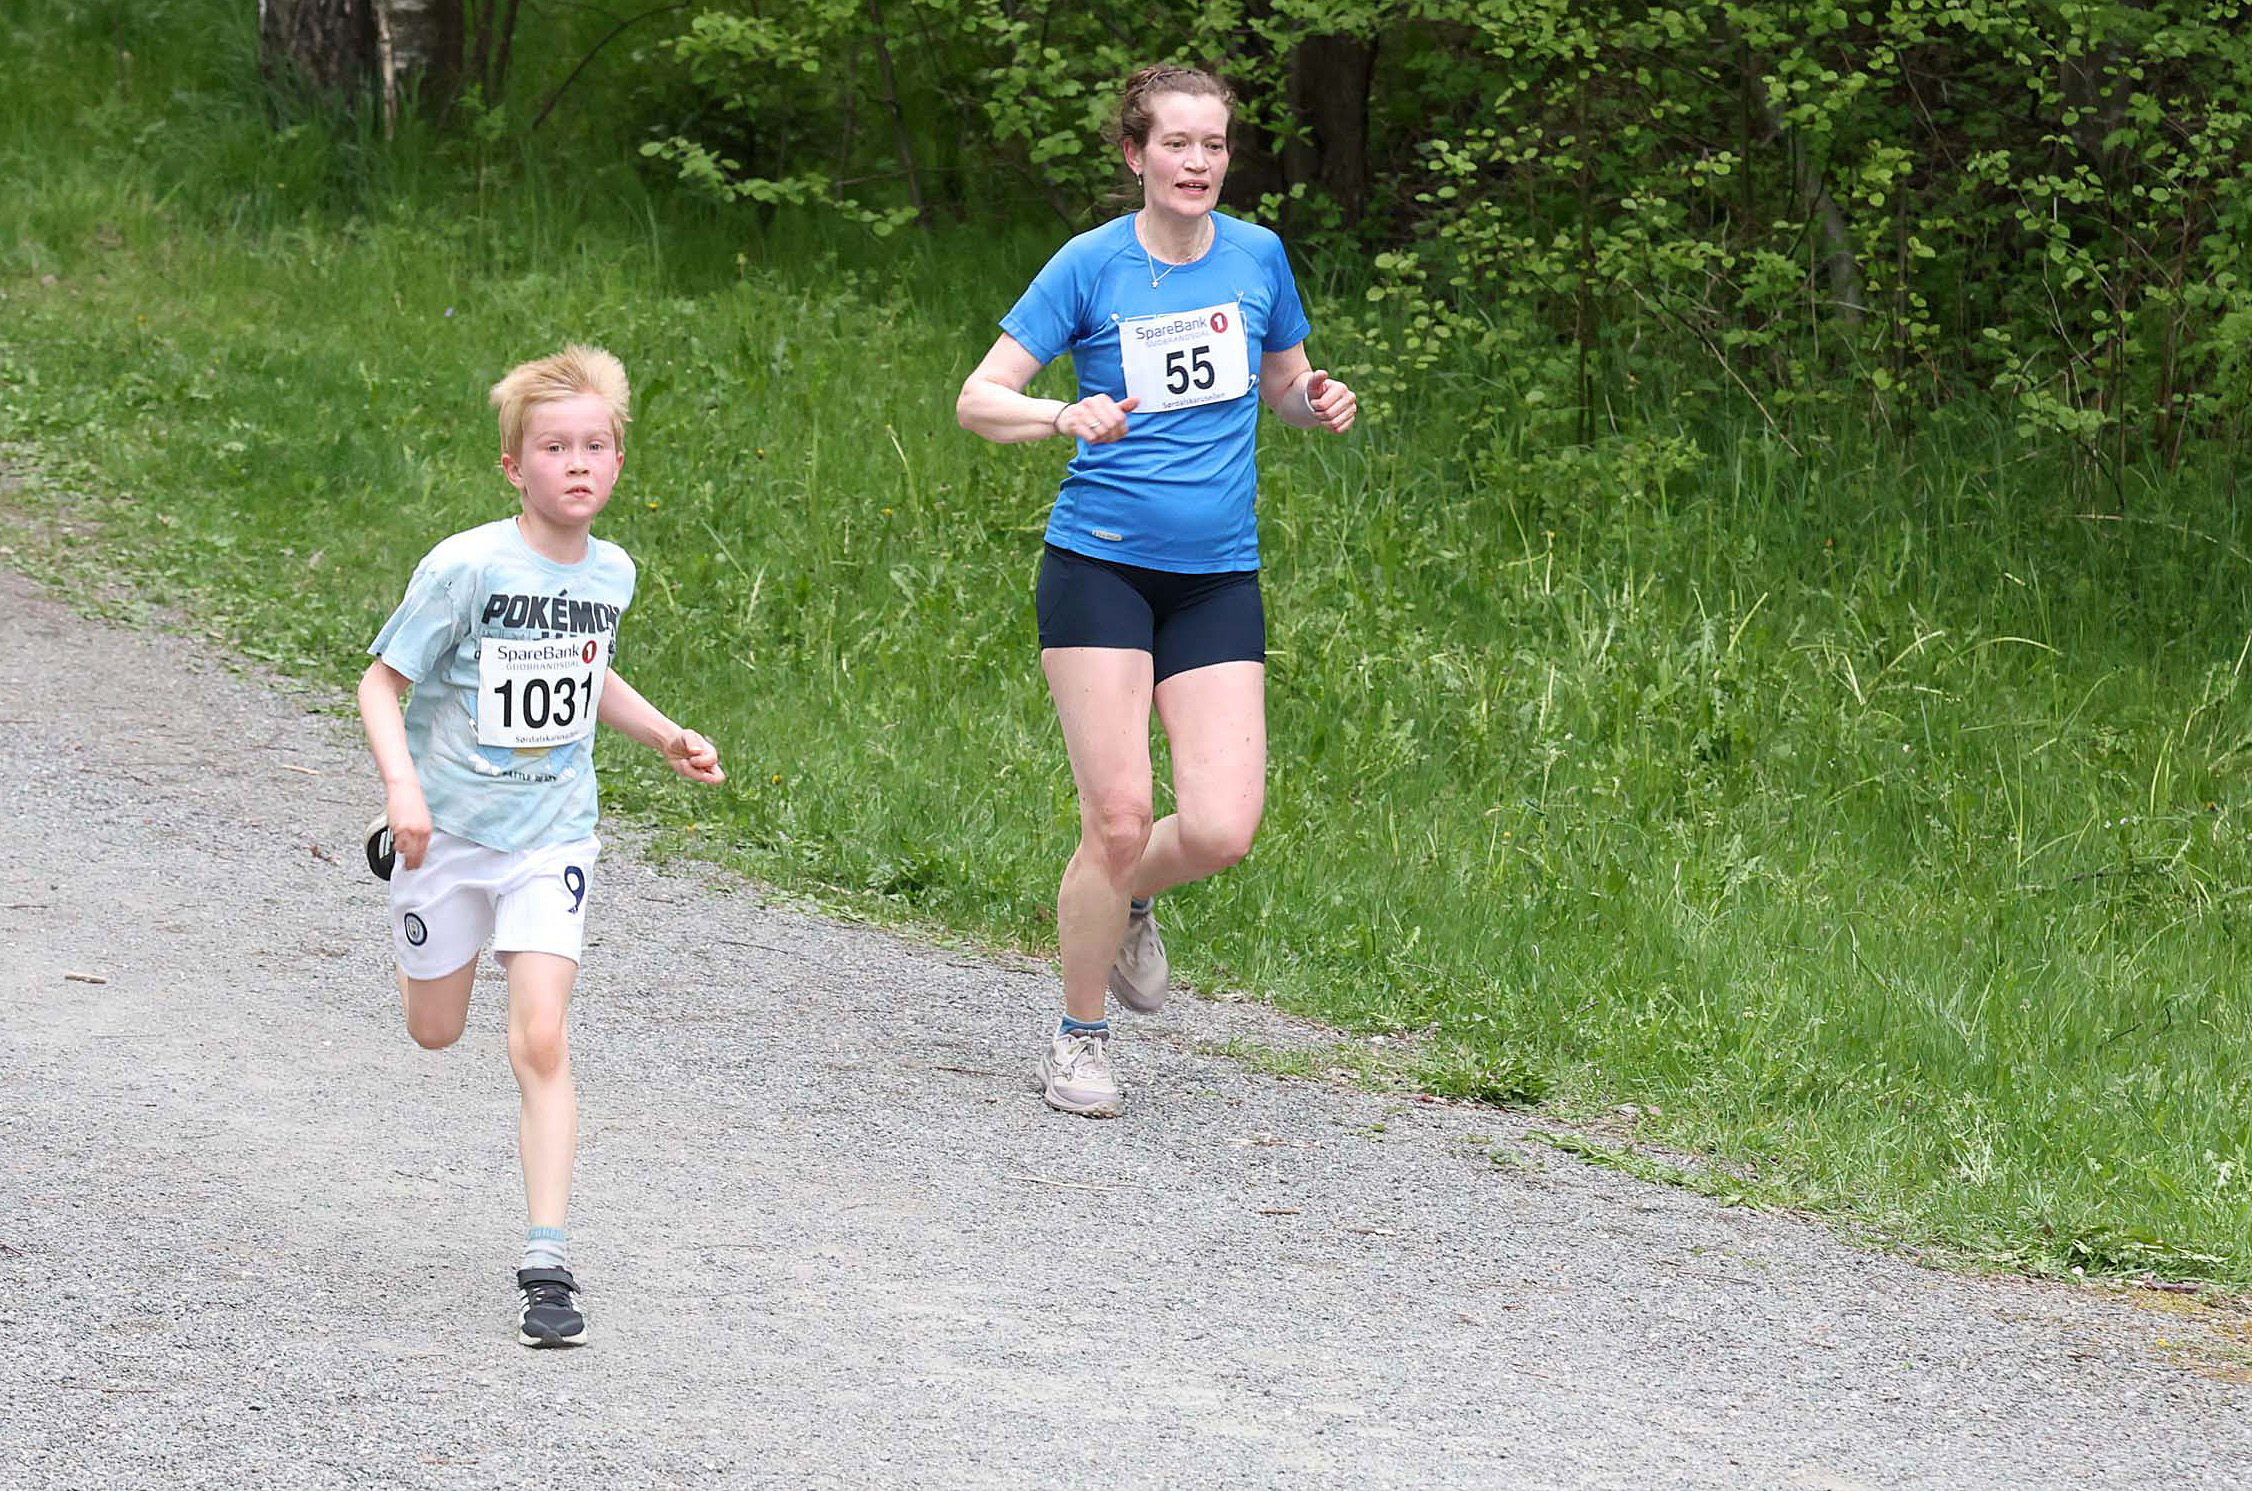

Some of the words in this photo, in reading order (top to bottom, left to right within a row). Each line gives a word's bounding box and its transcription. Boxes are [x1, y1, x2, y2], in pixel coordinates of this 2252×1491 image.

[1135, 317, 1208, 340] SpareBank
[1166, 345, 1215, 395] 55
[481, 588, 620, 635] POKÉMON
[498, 643, 579, 663] SpareBank
[494, 671, 593, 729] 1031
[564, 866, 586, 914] 9
